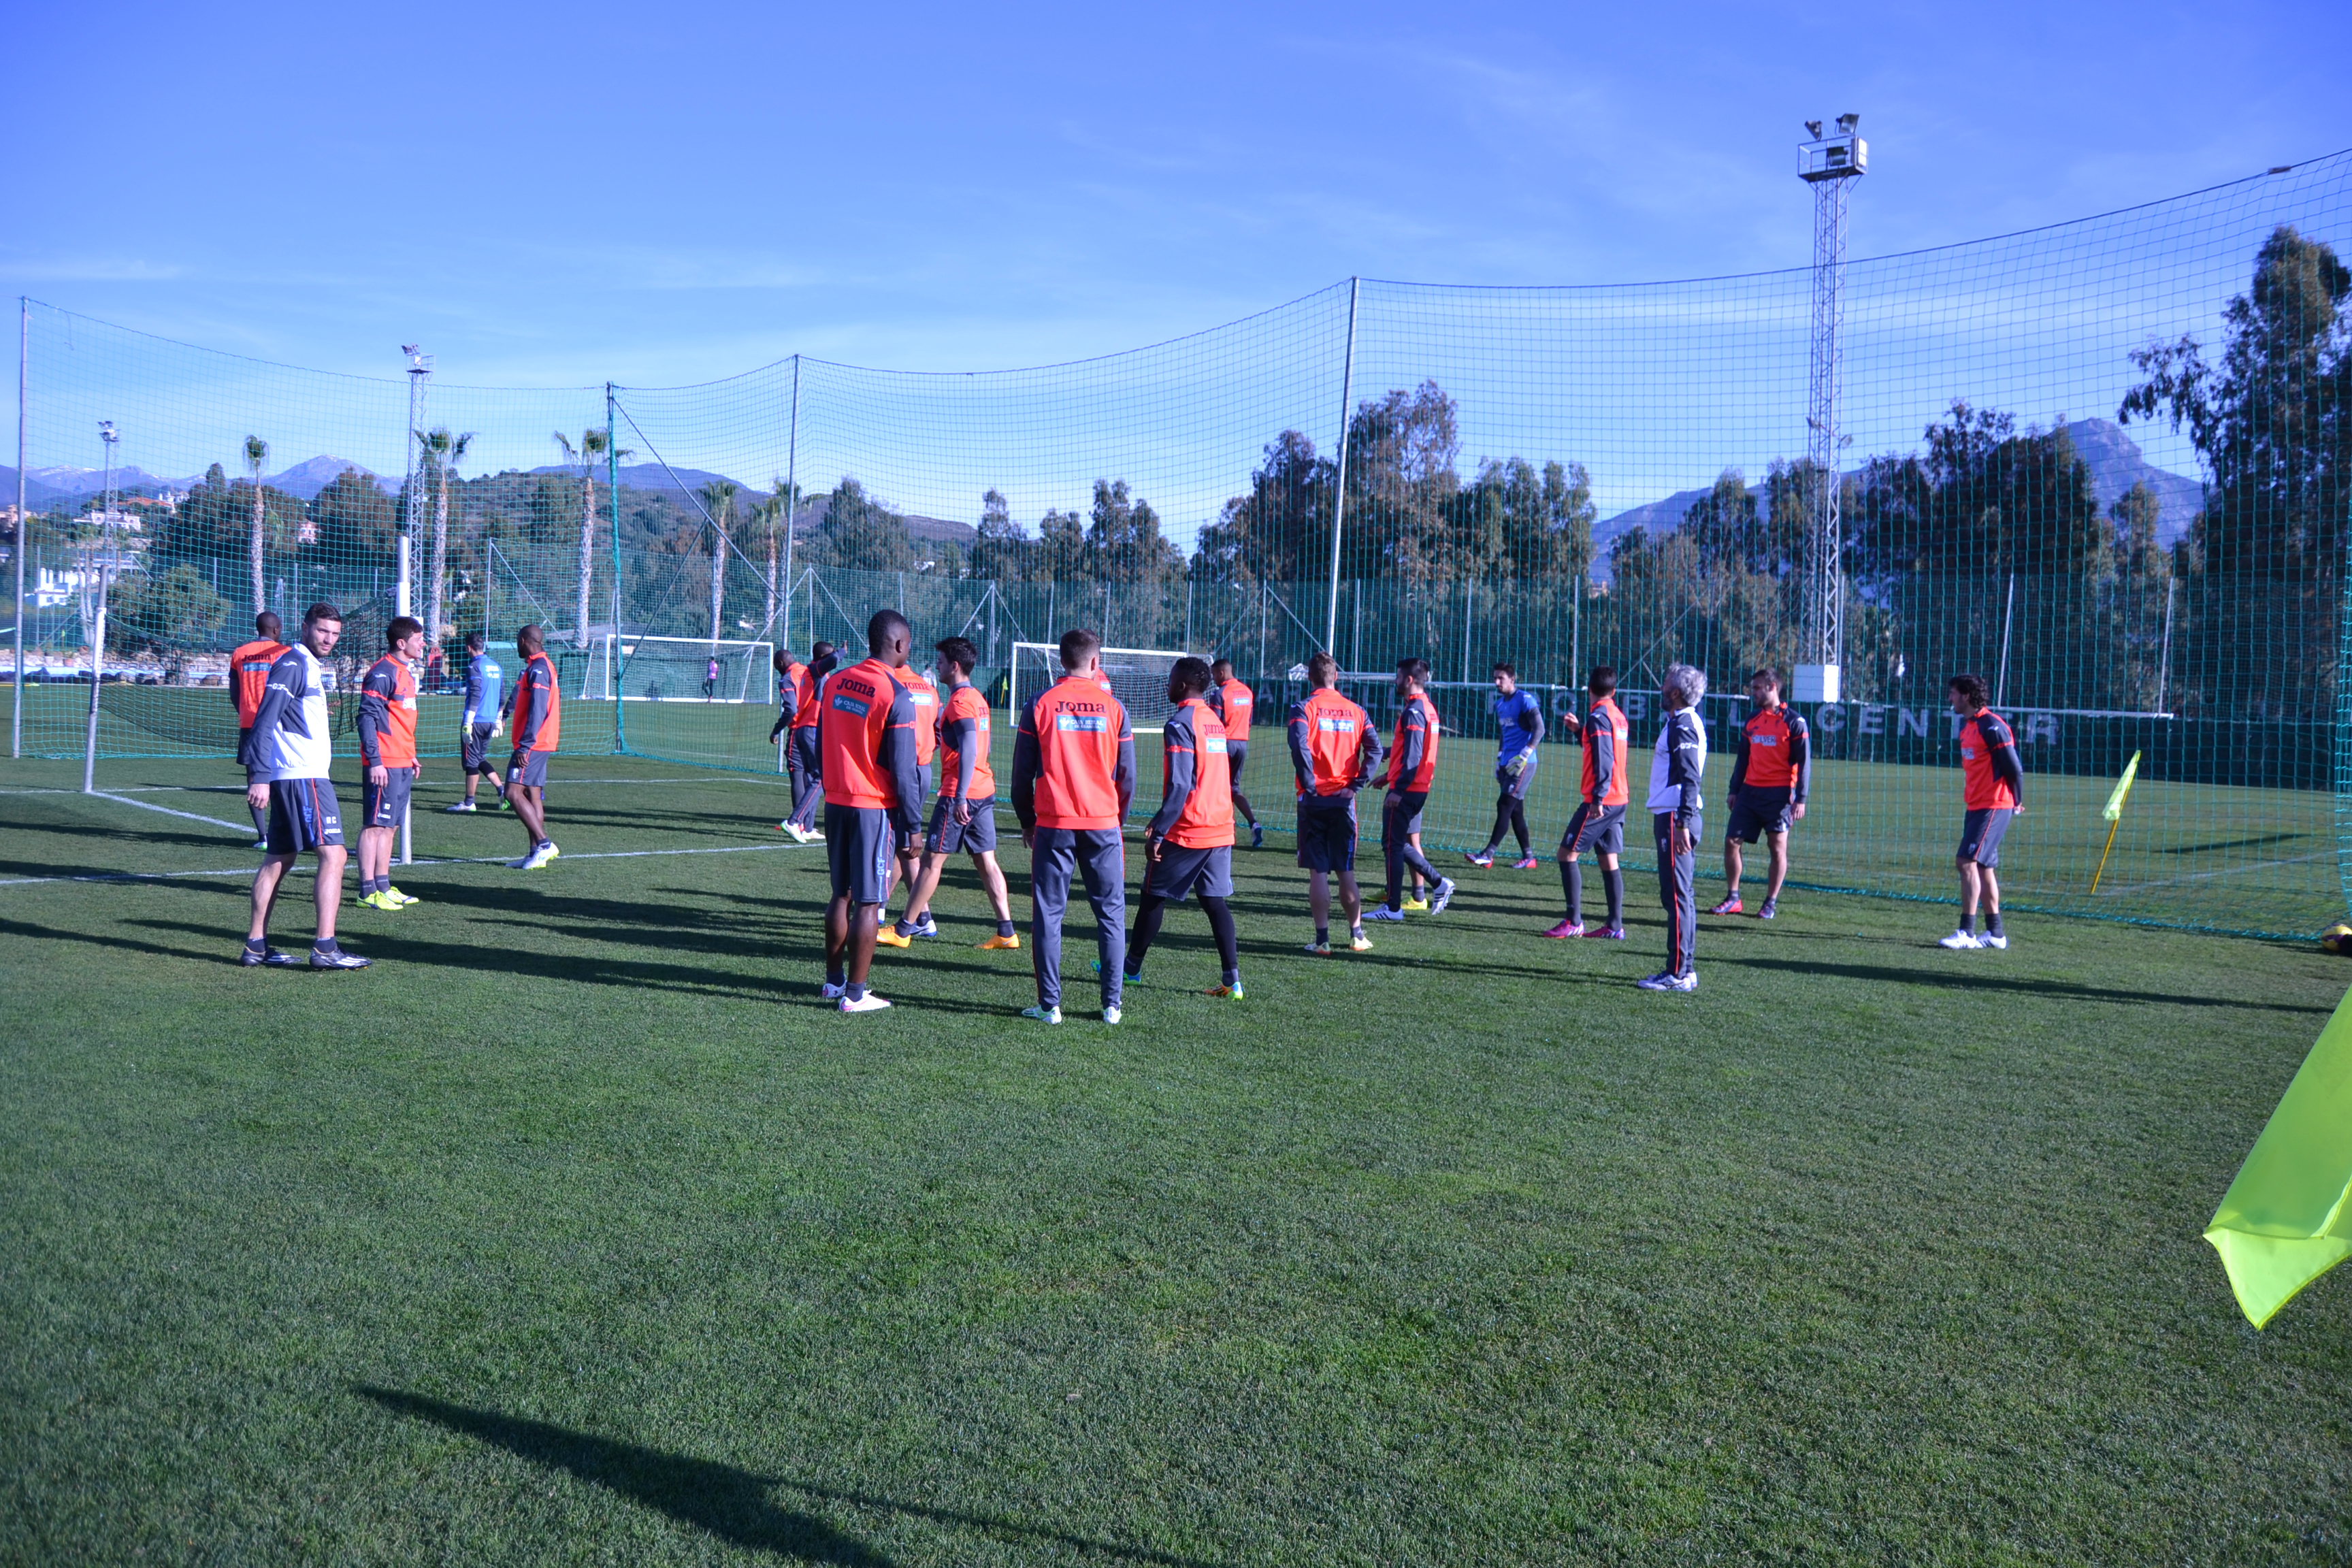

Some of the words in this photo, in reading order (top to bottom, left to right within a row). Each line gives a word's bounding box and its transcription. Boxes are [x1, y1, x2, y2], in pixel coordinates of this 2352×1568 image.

[836, 678, 876, 698] Joma
[1055, 700, 1107, 713] Joma
[1316, 708, 1352, 717] Joma
[877, 857, 885, 876] GCF
